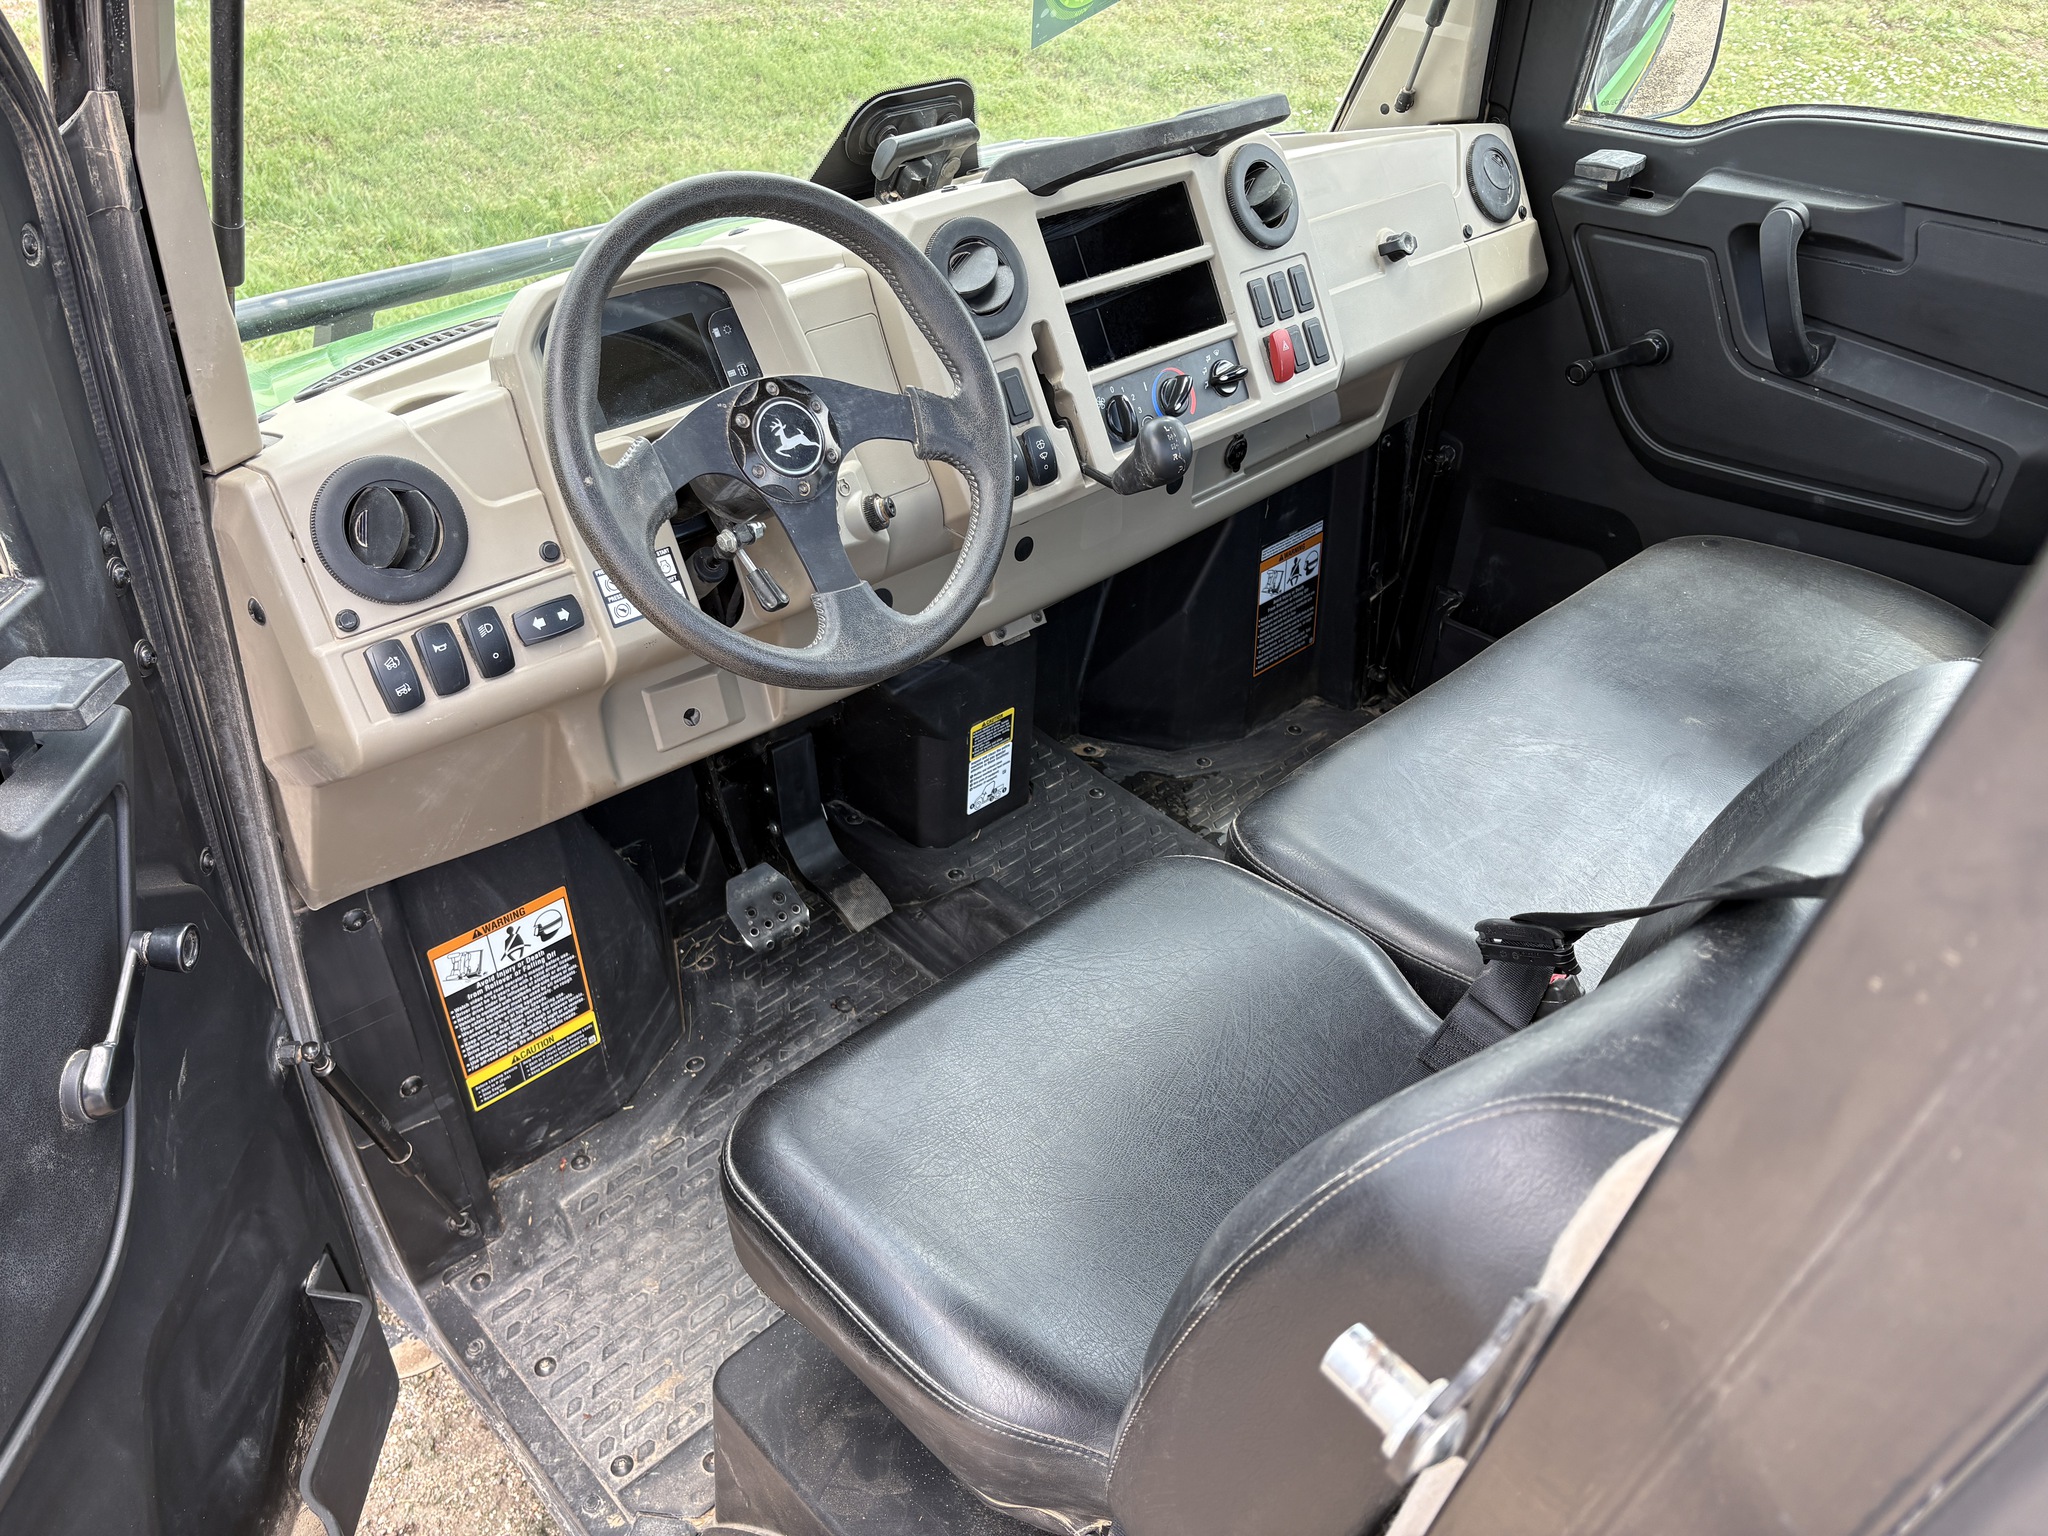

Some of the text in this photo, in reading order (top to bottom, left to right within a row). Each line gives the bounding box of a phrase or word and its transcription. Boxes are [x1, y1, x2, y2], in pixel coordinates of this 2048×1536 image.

[656, 548, 669, 556] START
[1284, 542, 1306, 560] WARNING
[608, 594, 623, 602] PRESS
[986, 714, 1003, 725] CAUTION
[482, 906, 526, 934] WARNING
[467, 950, 557, 1001] from Rollover or Falling Off
[476, 949, 545, 990] Avoid Injury or Death
[520, 1035, 555, 1059] CAUTION
